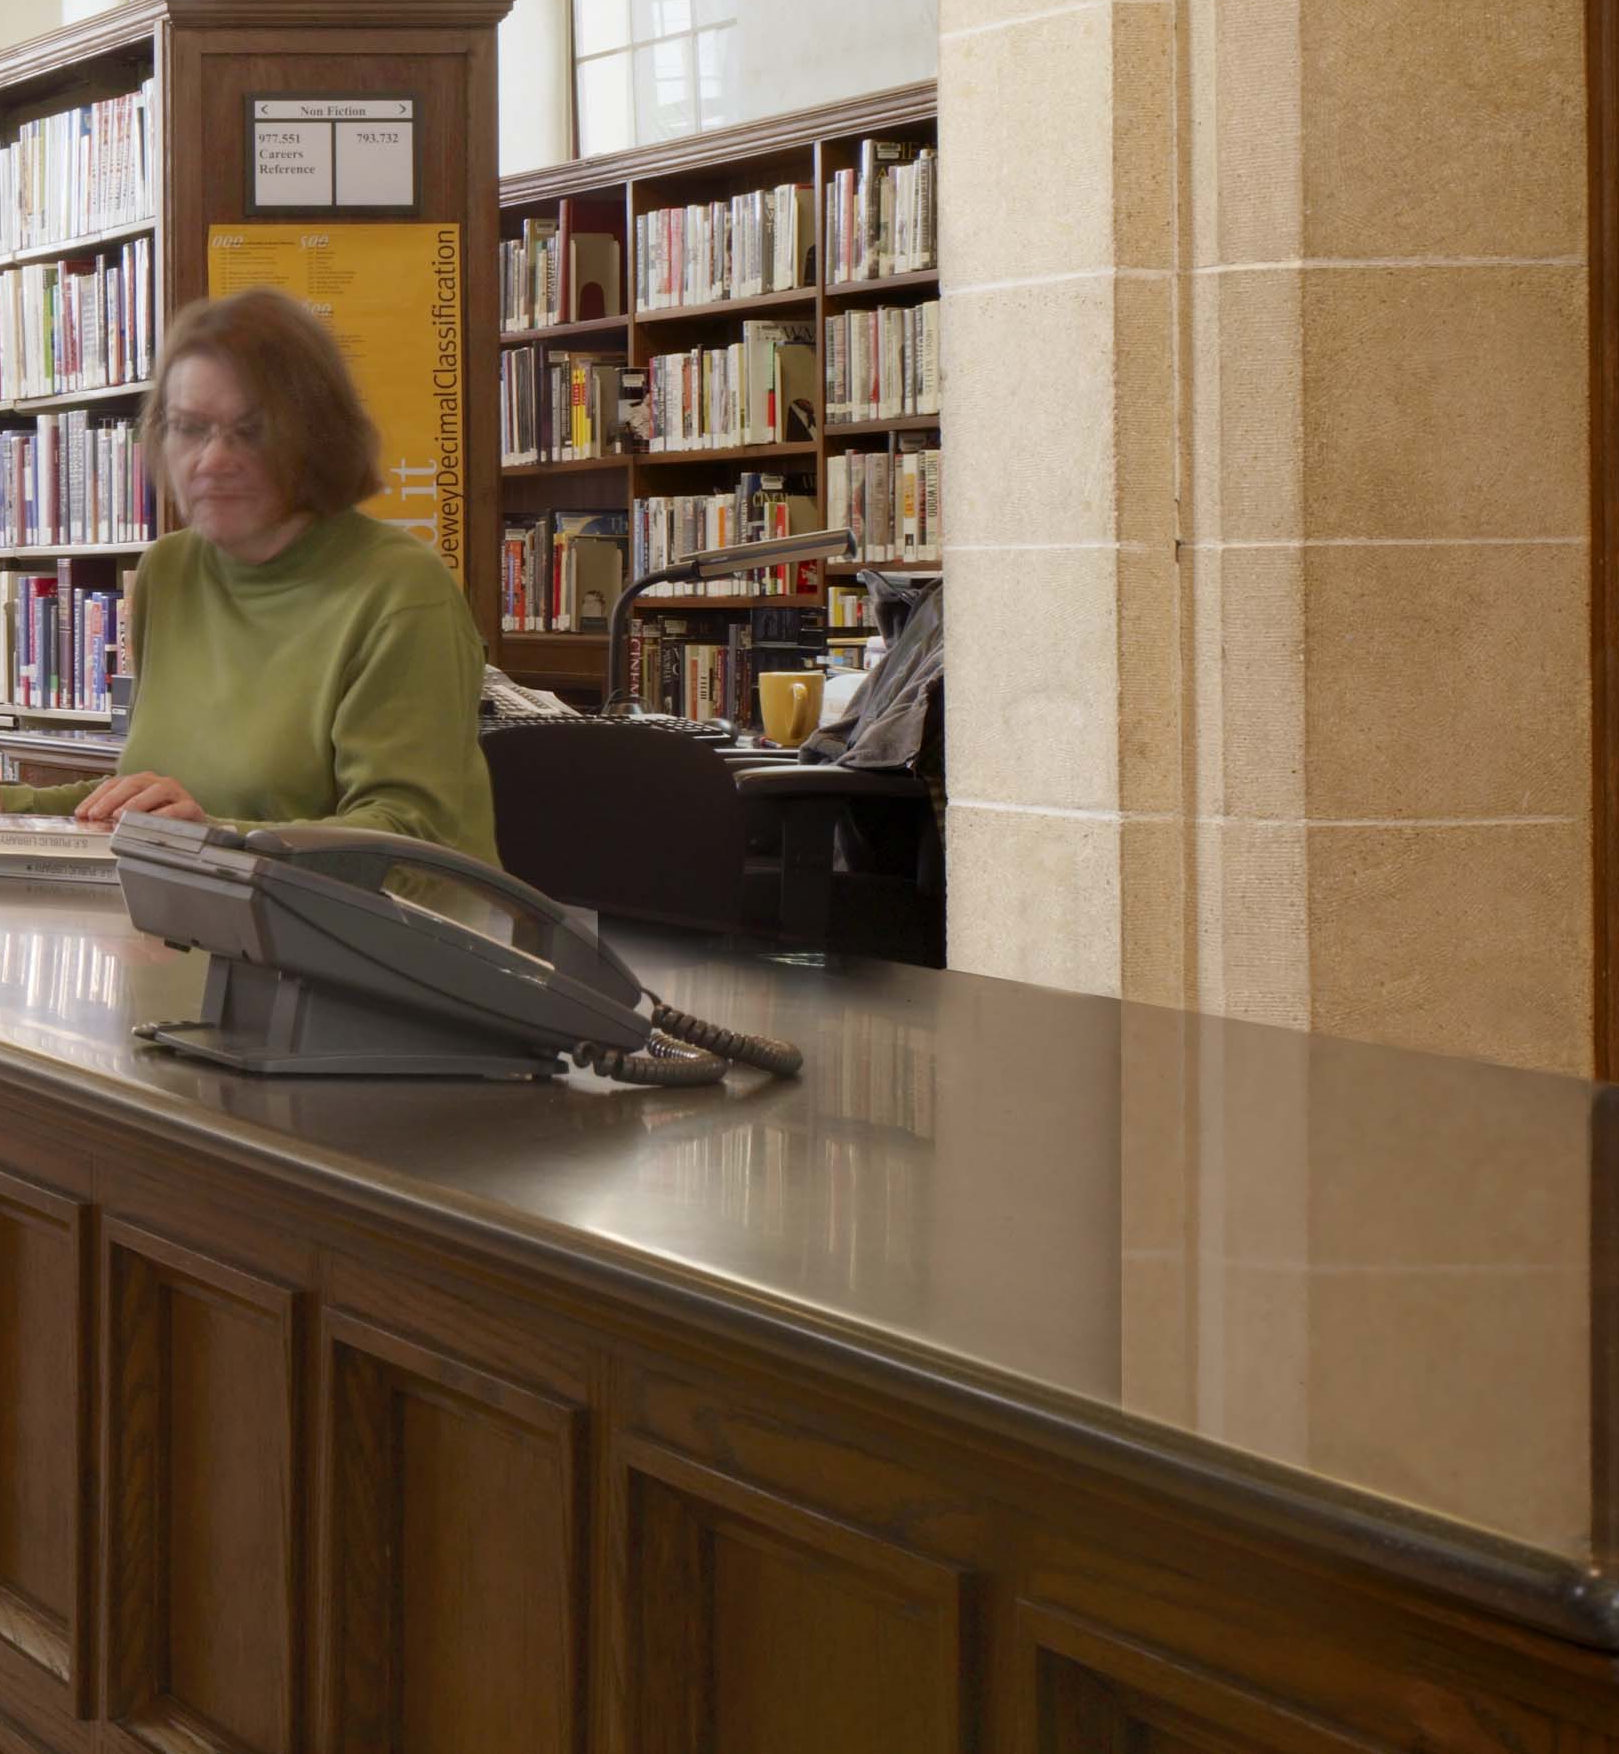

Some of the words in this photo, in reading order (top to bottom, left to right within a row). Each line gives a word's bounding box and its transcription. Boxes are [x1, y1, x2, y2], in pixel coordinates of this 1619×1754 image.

[301, 106, 324, 116] Non
[327, 105, 366, 116] Fiction
[258, 133, 301, 144] 977.551
[356, 133, 399, 144] 793.732
[259, 148, 304, 159] Careers
[259, 163, 316, 174] Reference
[927, 460, 938, 517] HOLLYWOOD
[0, 834, 37, 847] LIBRARY
[39, 836, 72, 848] PUBLIC
